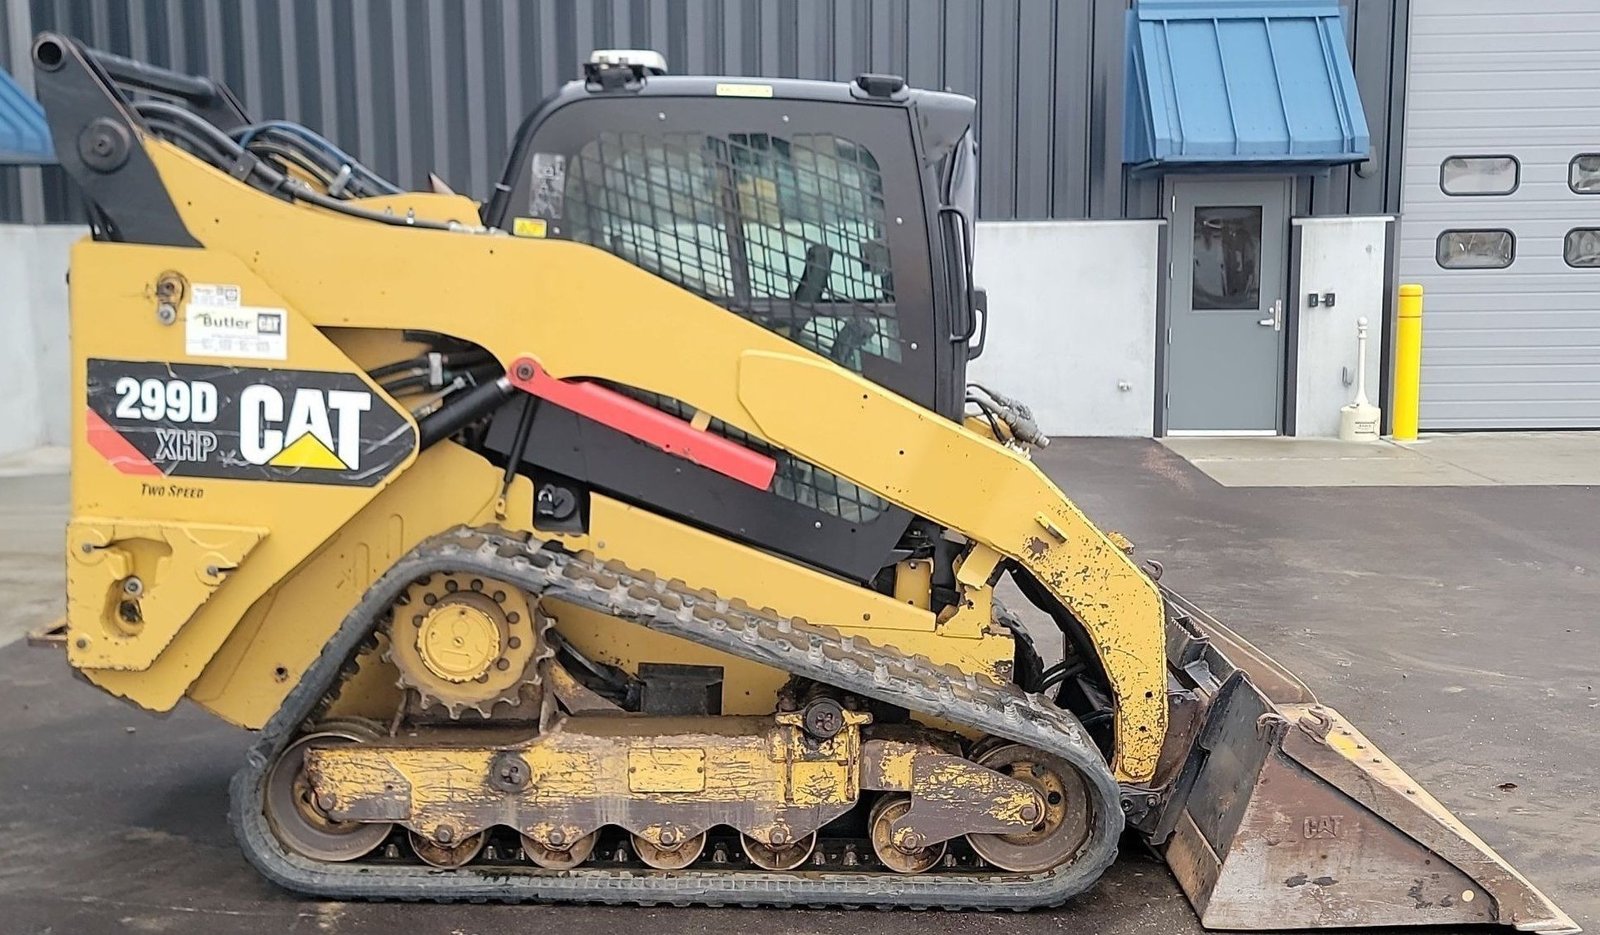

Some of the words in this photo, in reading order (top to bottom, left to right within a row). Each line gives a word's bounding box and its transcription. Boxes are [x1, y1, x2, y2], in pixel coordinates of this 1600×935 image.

[203, 313, 250, 329] Butler
[115, 376, 218, 423] 299D
[240, 384, 372, 471] CAT
[156, 429, 218, 463] XHP
[1303, 815, 1344, 839] CAT
